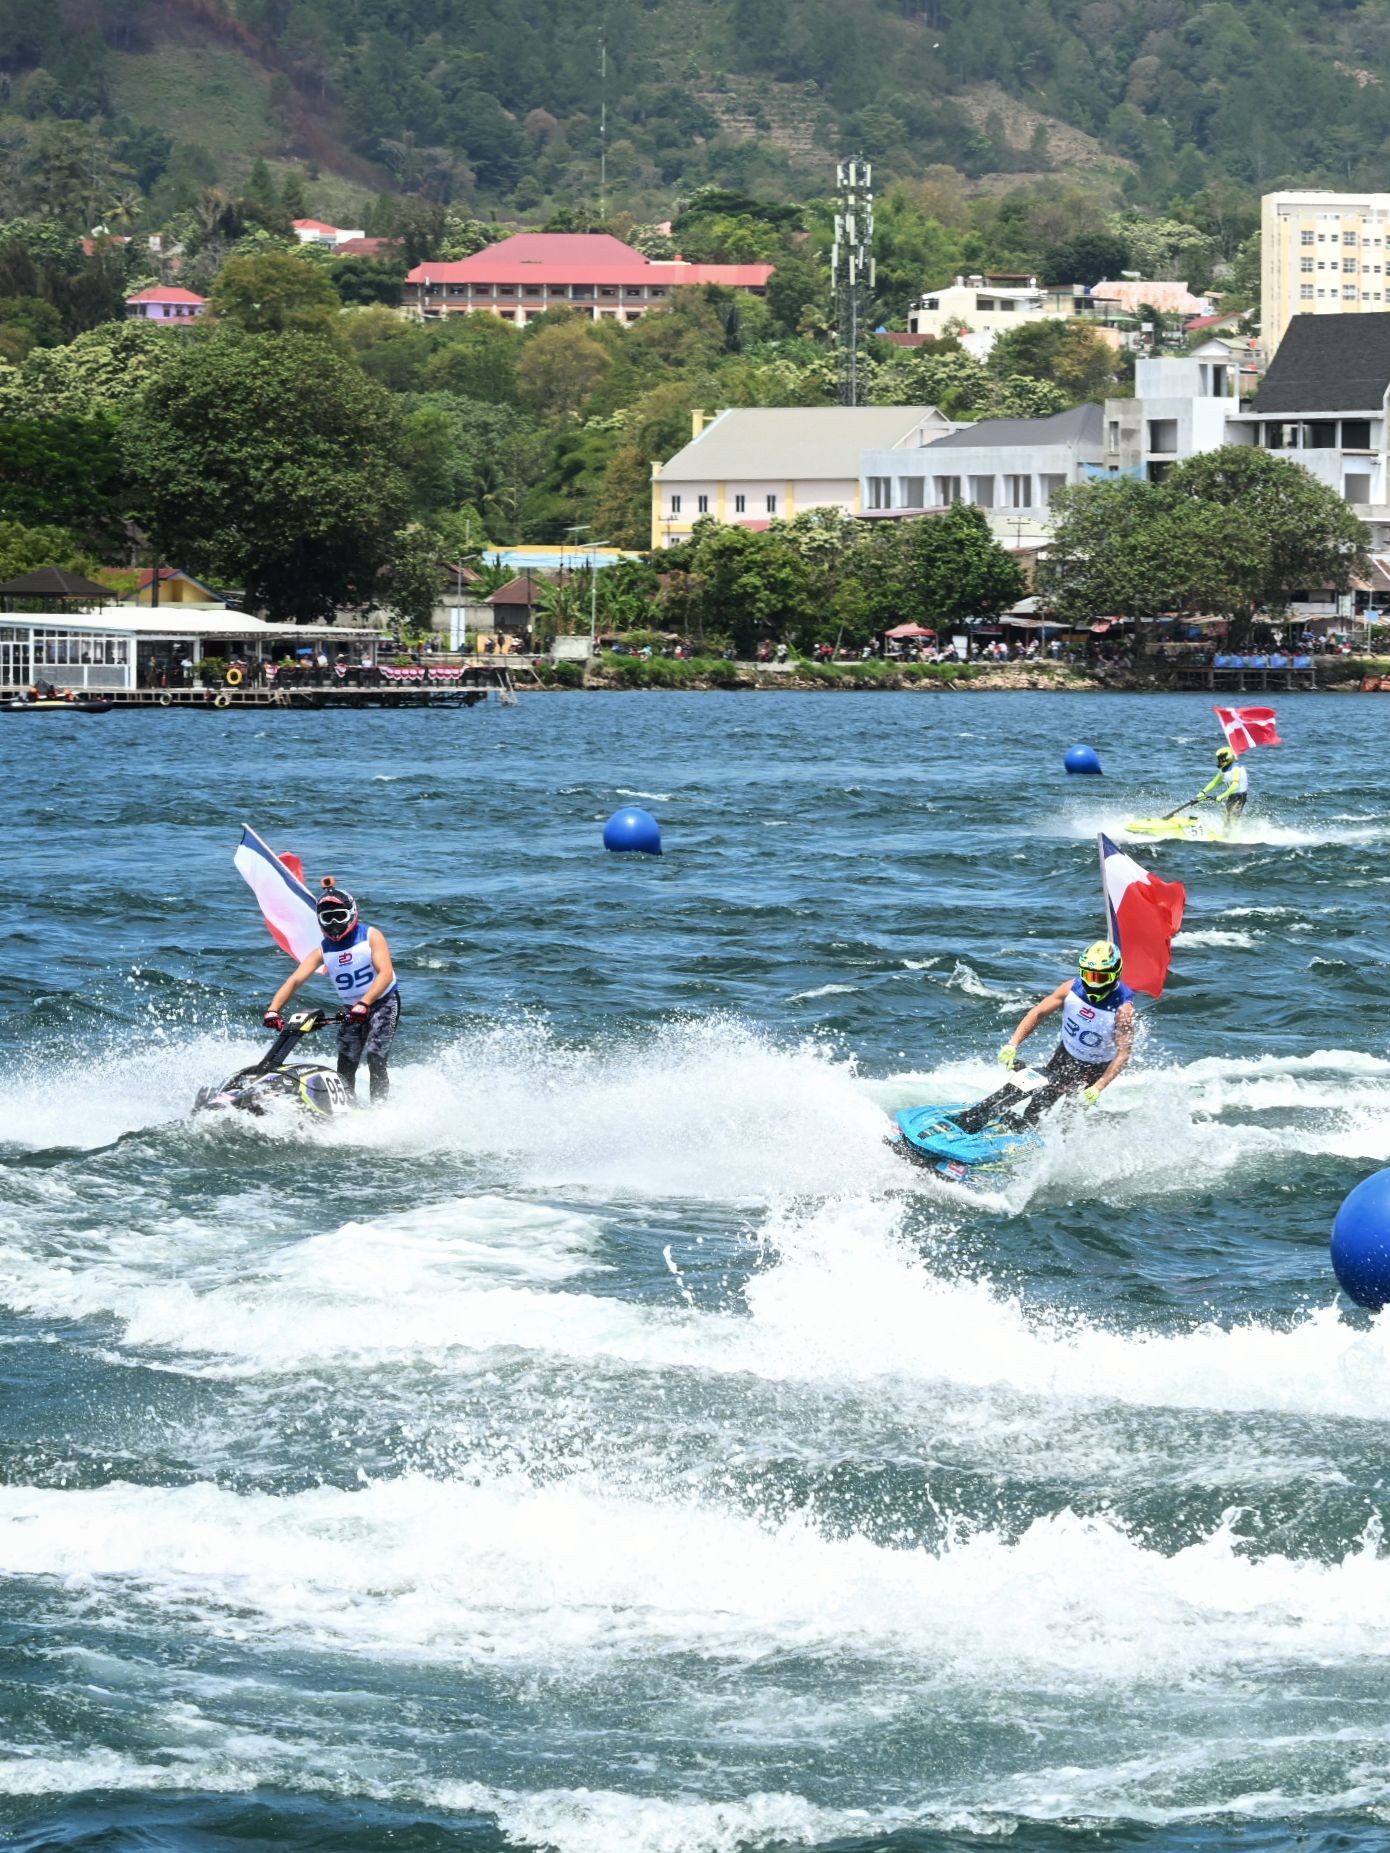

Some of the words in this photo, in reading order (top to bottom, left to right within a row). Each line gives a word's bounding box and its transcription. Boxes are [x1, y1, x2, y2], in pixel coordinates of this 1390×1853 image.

[335, 964, 374, 991] 95
[1064, 1016, 1104, 1047] 30
[326, 1077, 346, 1106] 95
